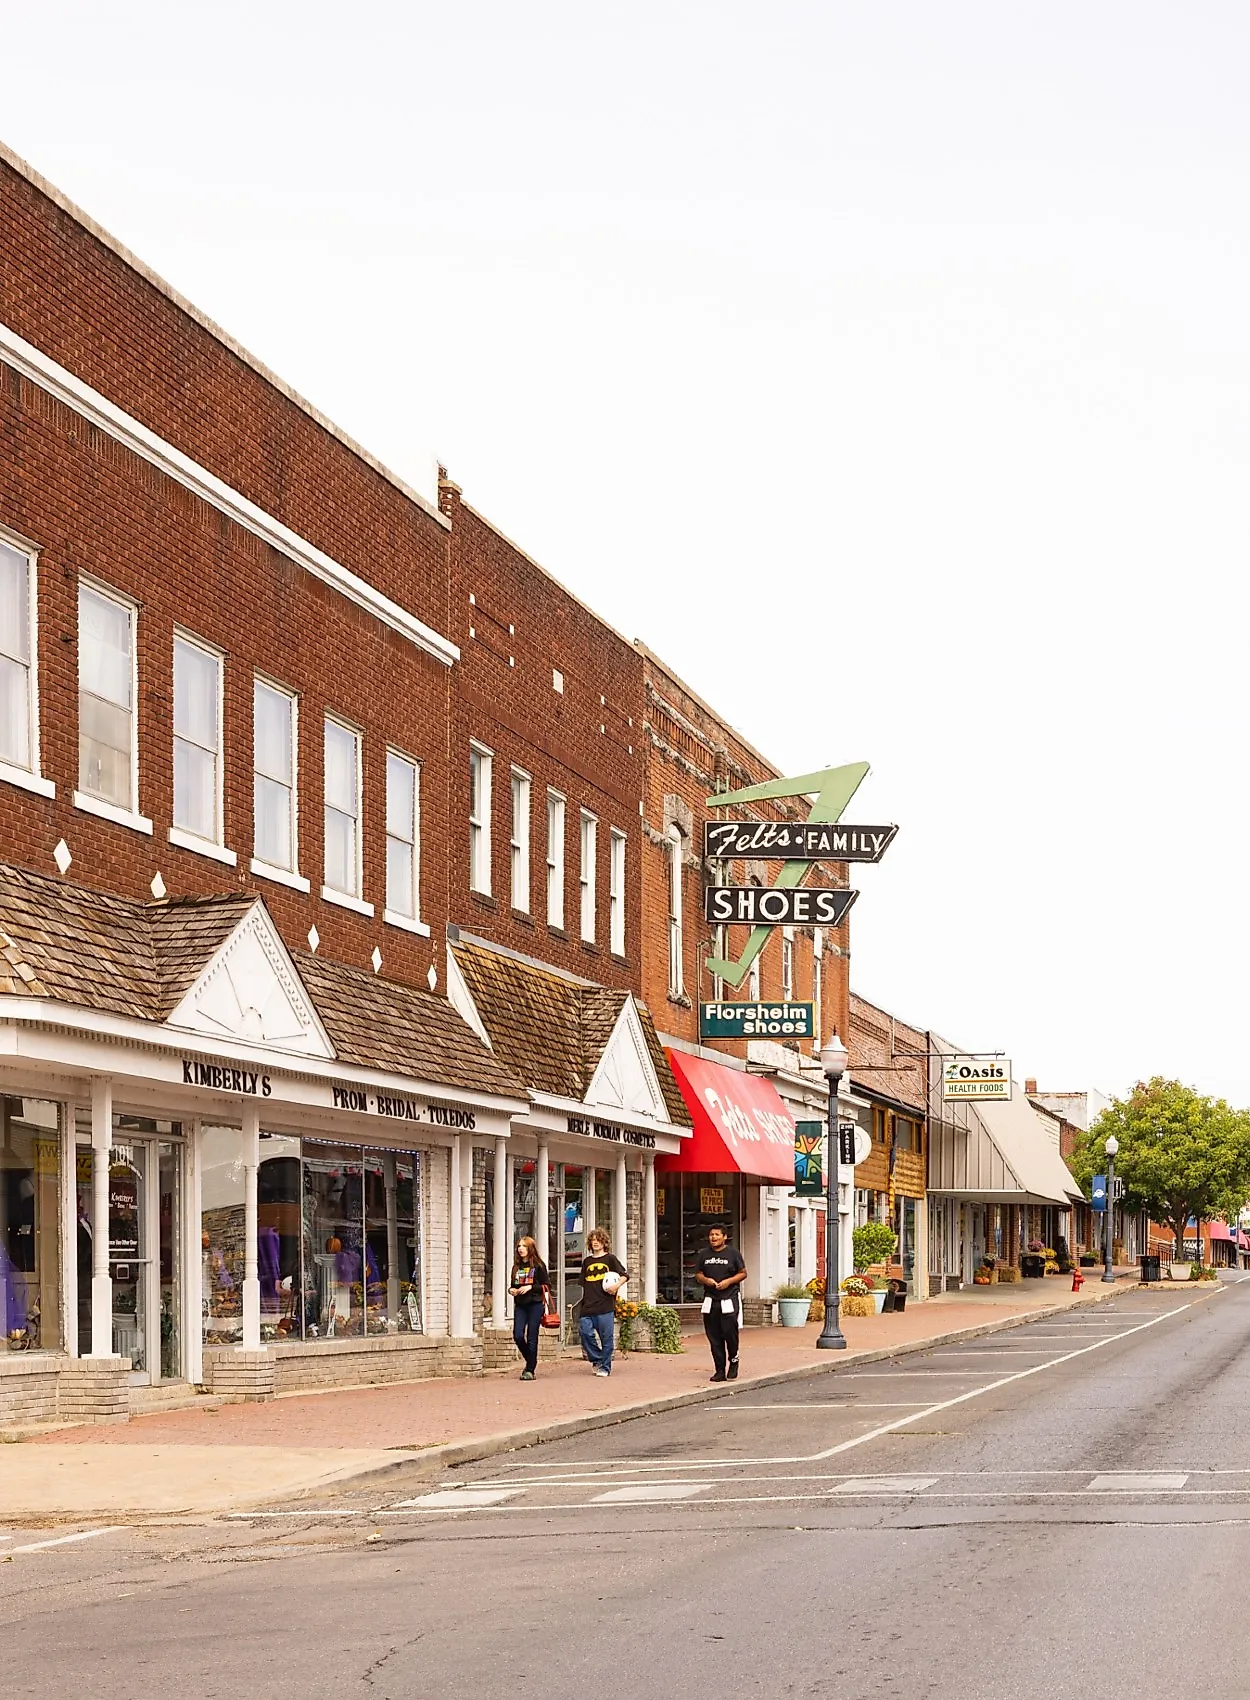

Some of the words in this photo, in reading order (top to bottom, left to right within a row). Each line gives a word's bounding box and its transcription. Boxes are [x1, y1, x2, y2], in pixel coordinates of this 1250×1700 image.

[708, 823, 791, 856] Felts
[807, 831, 885, 852] FAMILY
[713, 889, 836, 922] SHOES
[705, 1004, 807, 1020] Florsheim
[743, 1019, 807, 1034] shoes
[948, 1084, 977, 1093] HEALTH
[979, 1083, 1004, 1092] FOODS
[332, 1087, 368, 1112] PROM
[376, 1095, 420, 1121] BRIDAL
[427, 1105, 476, 1130] TUXEDOS
